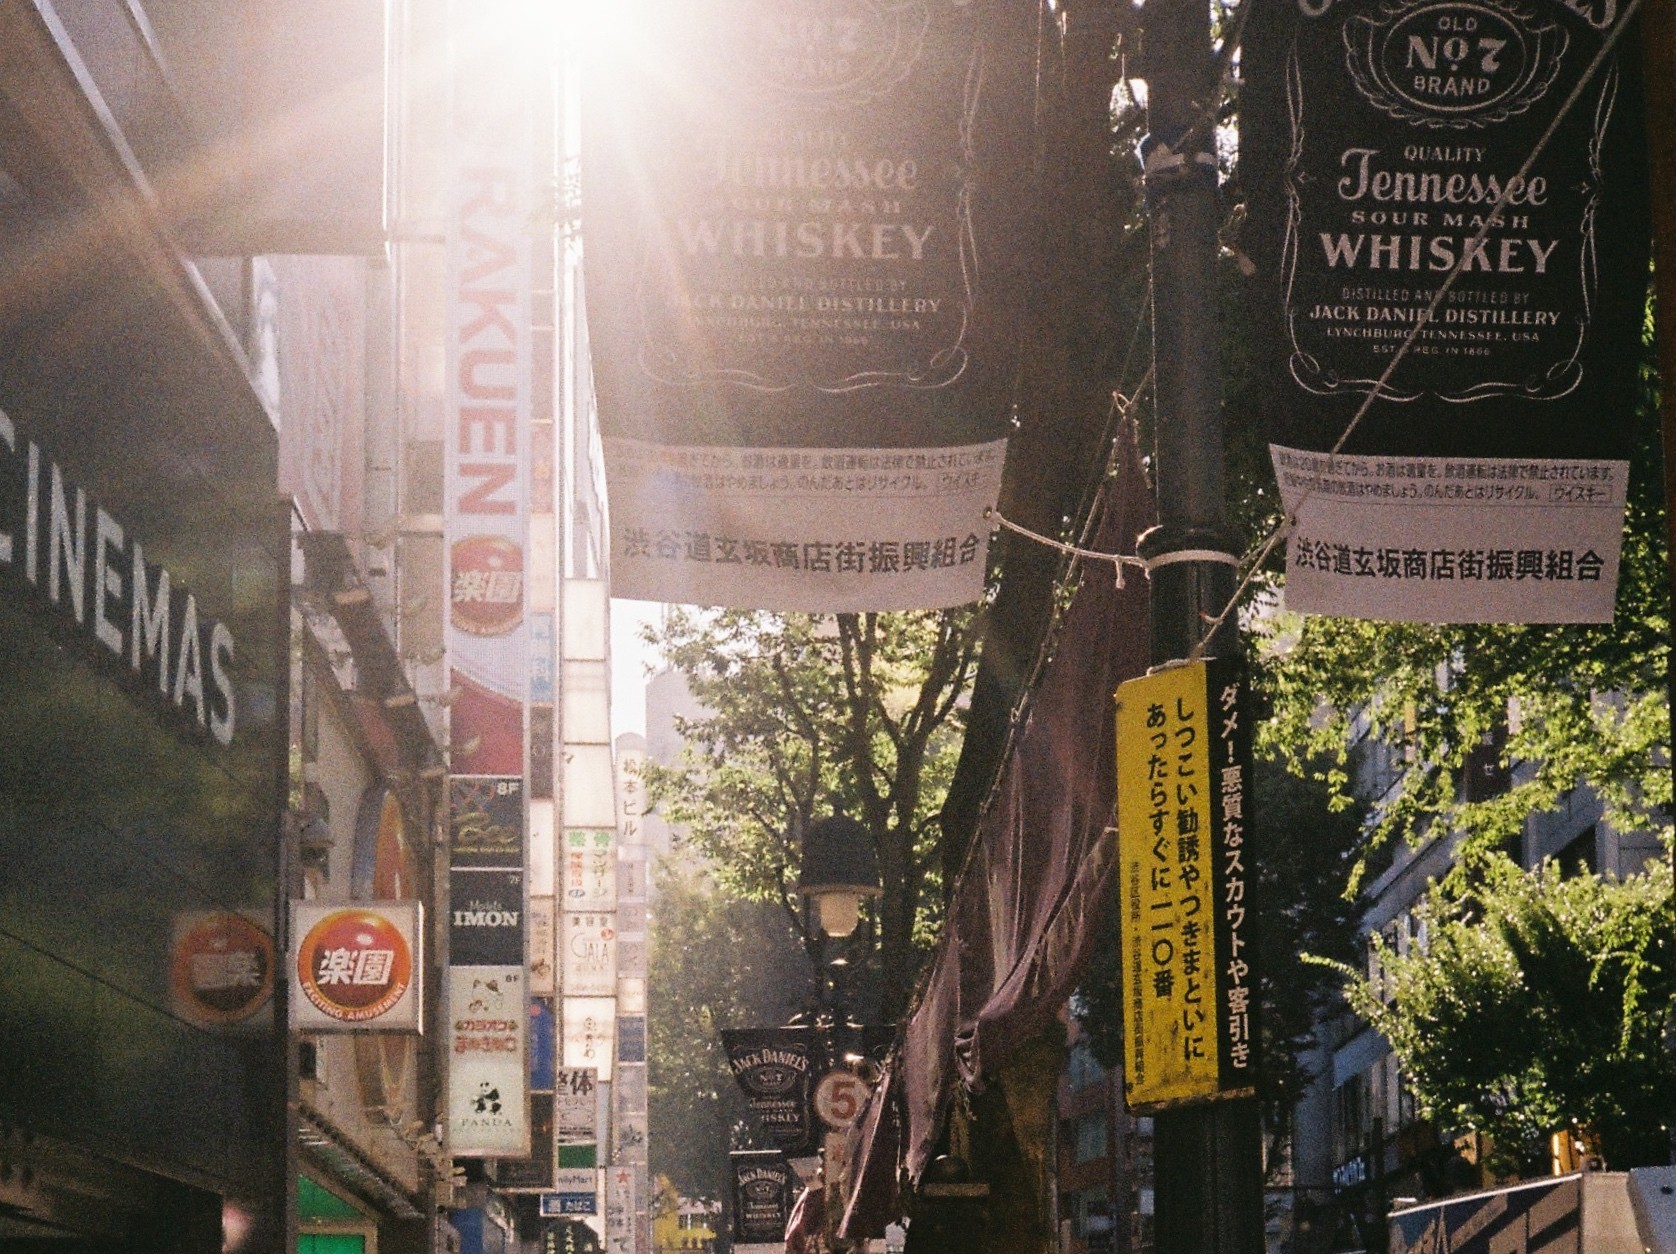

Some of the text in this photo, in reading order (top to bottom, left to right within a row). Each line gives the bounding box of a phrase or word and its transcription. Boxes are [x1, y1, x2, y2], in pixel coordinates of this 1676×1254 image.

[1438, 16, 1477, 31] OLD
[1414, 75, 1490, 97] BRAND
[1403, 145, 1487, 162] QUALITY
[1338, 147, 1548, 205] Tennessee
[1351, 210, 1529, 230] SOUR MASH
[675, 217, 935, 260] WHISKEY
[1319, 232, 1560, 274] WHISKEY
[817, 296, 942, 314] DISTILLERY
[1342, 287, 1409, 302] DISTILLED
[1513, 292, 1530, 305] BY
[1309, 304, 1561, 326] JACK DANIEL DISTILLERY
[457, 166, 518, 516] RAKUEN
[1512, 331, 1540, 342] USA
[623, 527, 981, 574] 渋谷道玄坂商店街振興組合
[1294, 536, 1605, 581] 渋谷道玄坂商店街振興組合
[453, 569, 524, 604] 楽園
[1174, 697, 1205, 1061] しつこい勧誘やつきまといに
[453, 910, 520, 928] IMON
[318, 947, 395, 985] 楽園
[347, 982, 406, 1020] AMUSEMENT
[831, 1081, 857, 1120] 5
